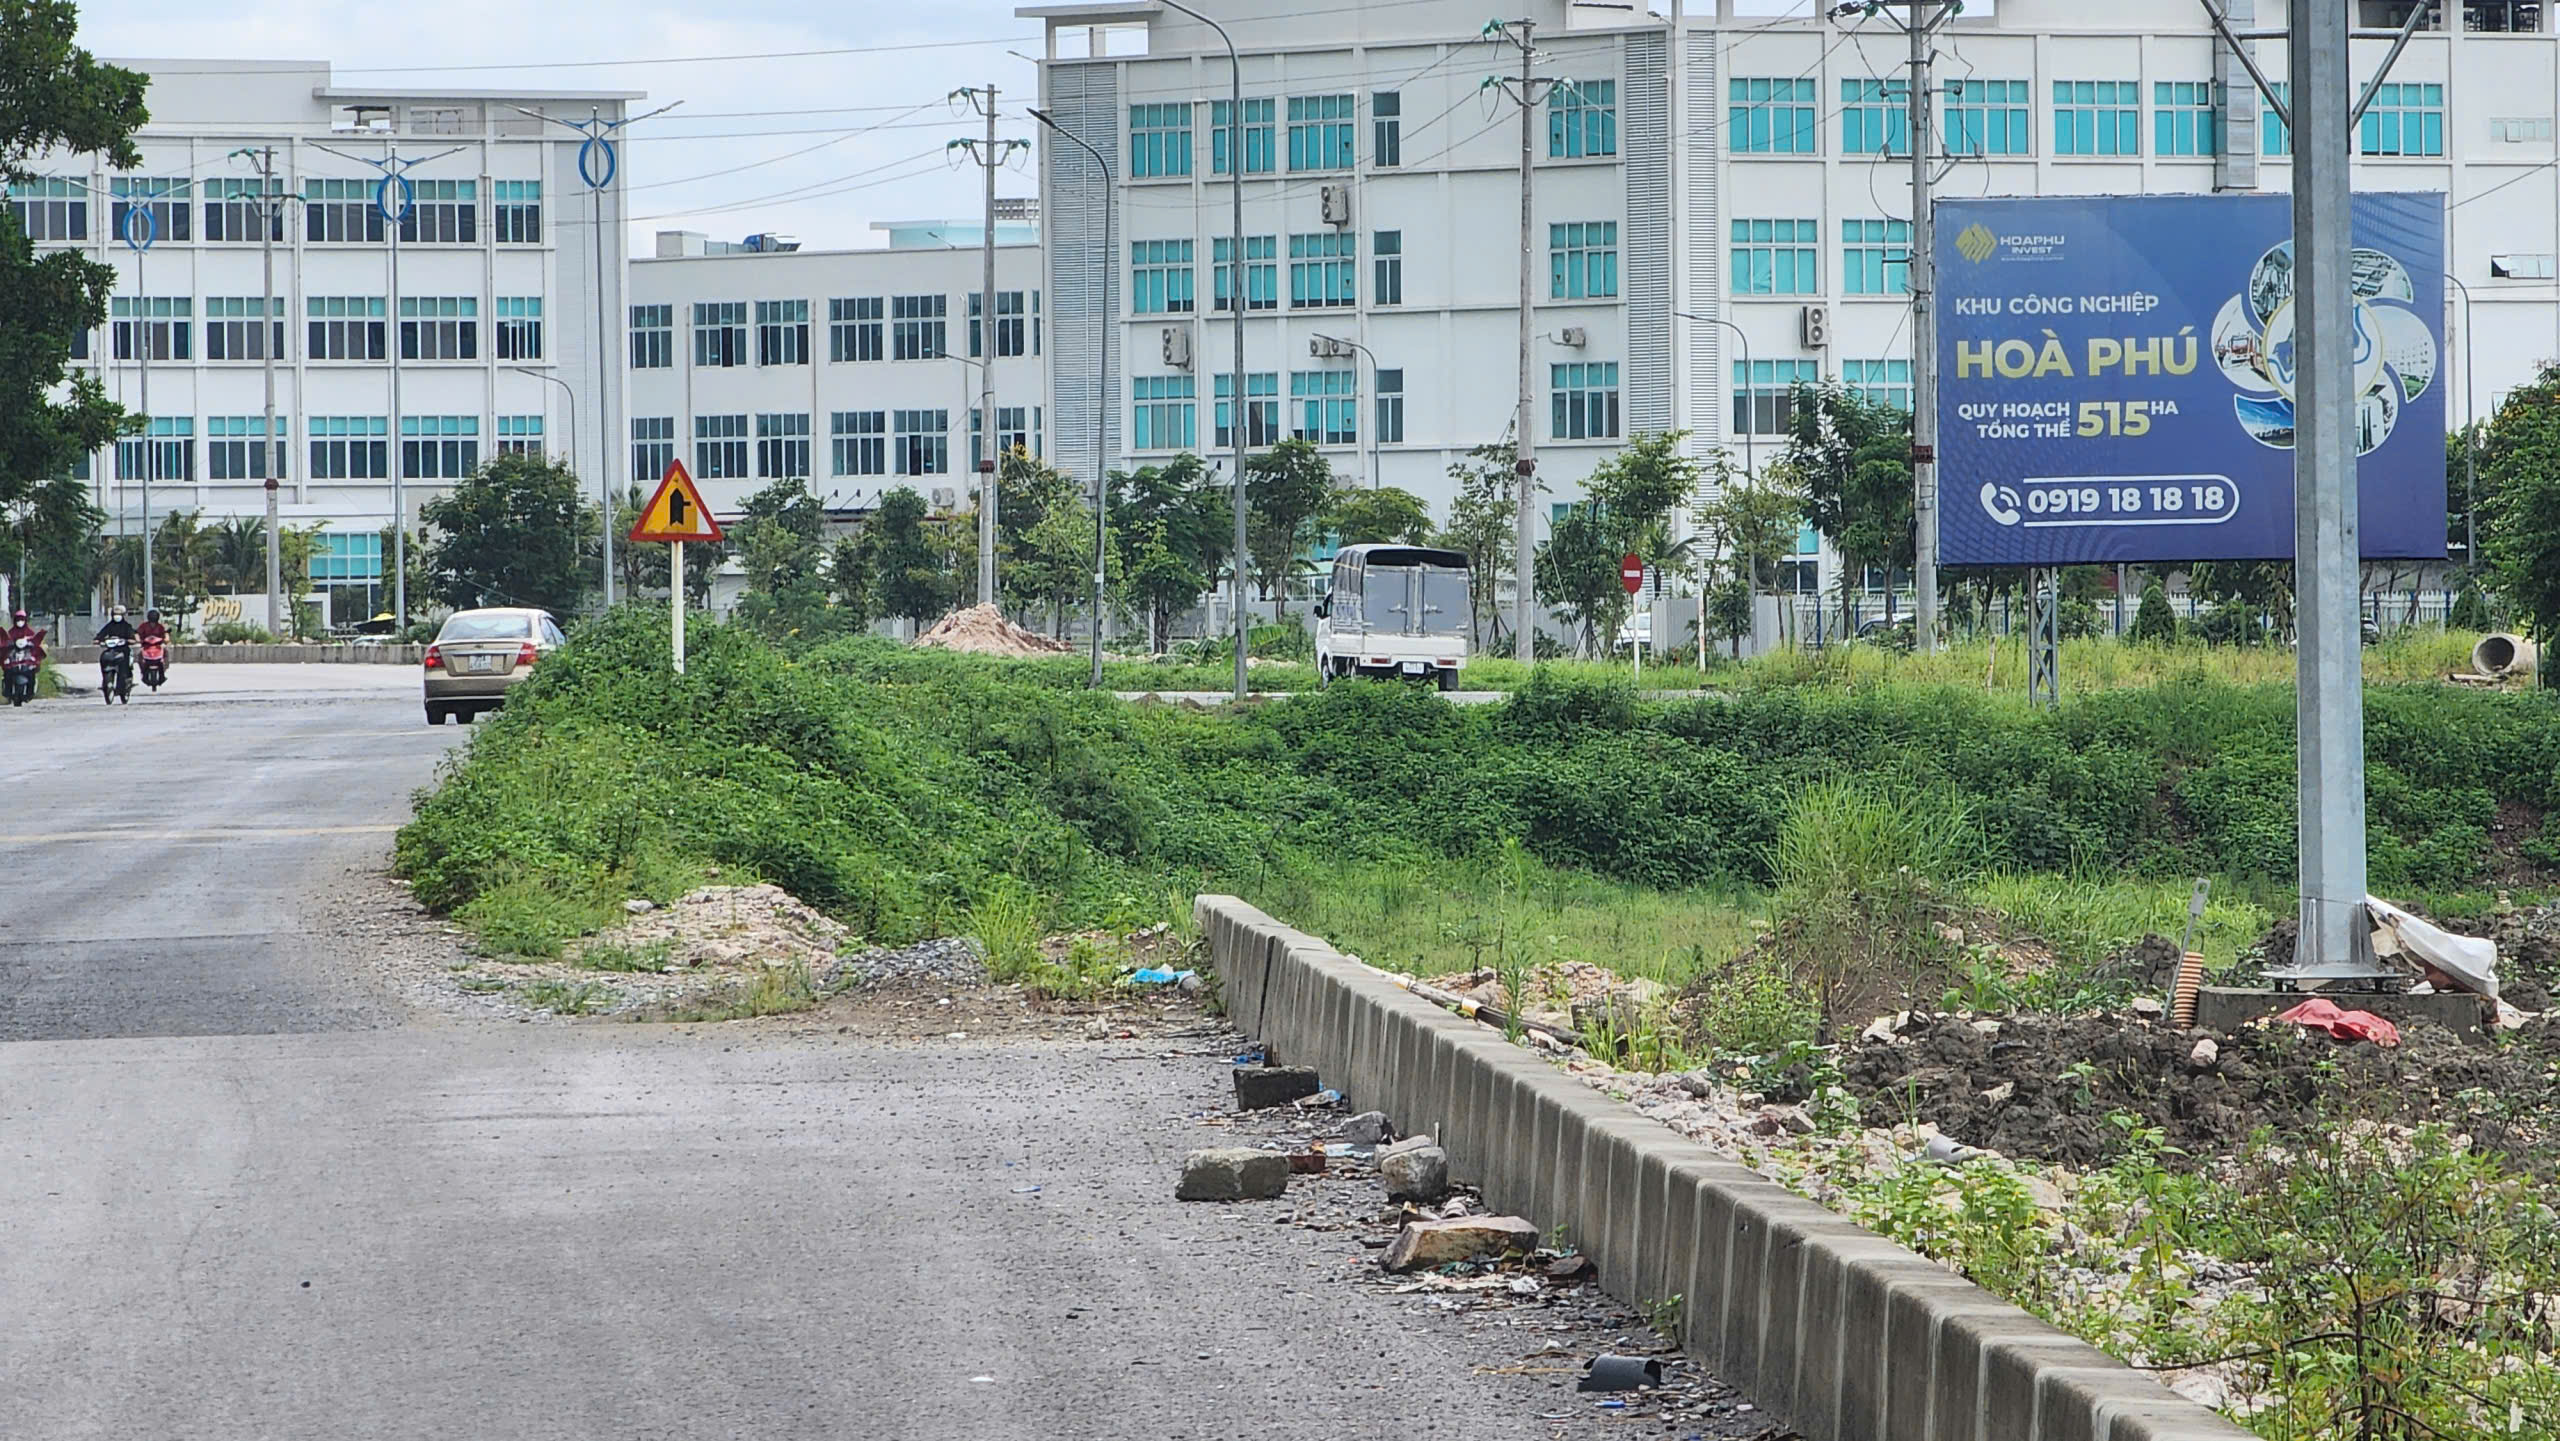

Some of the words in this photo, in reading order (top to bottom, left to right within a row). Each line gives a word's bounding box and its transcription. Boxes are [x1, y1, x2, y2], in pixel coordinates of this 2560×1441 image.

[2011, 246, 2053, 254] INVEST
[1955, 298, 2001, 315] KHU
[2008, 294, 2073, 315] CÔNG
[2079, 291, 2159, 317] NGHIỆP
[1957, 328, 2074, 379] HOÀ
[2088, 326, 2197, 376] PHÚ
[1958, 403, 1998, 420] QUY
[2003, 402, 2070, 421] HOẠCH
[2076, 401, 2151, 437] 515
[2151, 400, 2179, 415] HA
[1977, 420, 2029, 438] TỔNG
[2034, 418, 2070, 438] THỂ
[2027, 488, 2100, 514] 0919
[2108, 487, 2142, 512] 18
[2150, 486, 2184, 511] 18
[2191, 485, 2225, 511] 18
